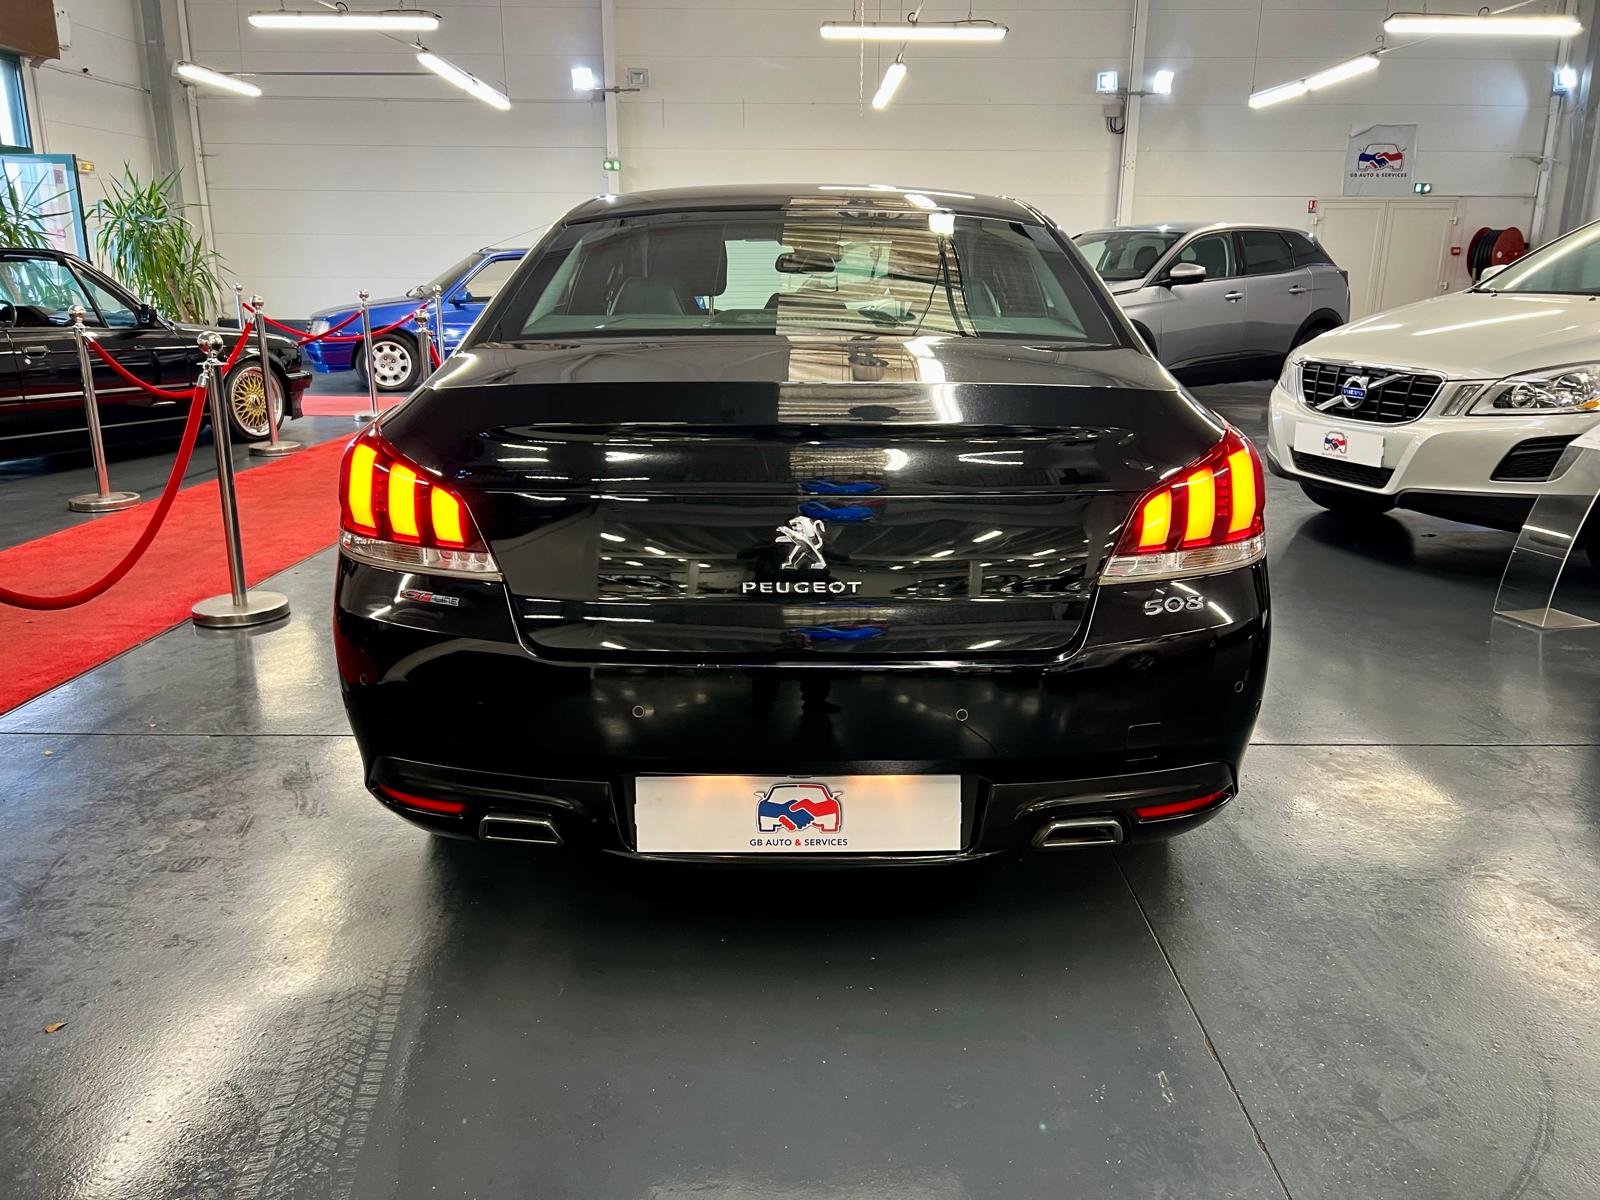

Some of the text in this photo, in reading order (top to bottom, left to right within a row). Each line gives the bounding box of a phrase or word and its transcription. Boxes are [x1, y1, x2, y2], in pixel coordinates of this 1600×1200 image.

[1343, 388, 1364, 396] VOLVO
[742, 581, 862, 593] PEUGEOT
[1144, 595, 1204, 616] 508
[749, 838, 848, 846] GB AUTO & SERVICES
